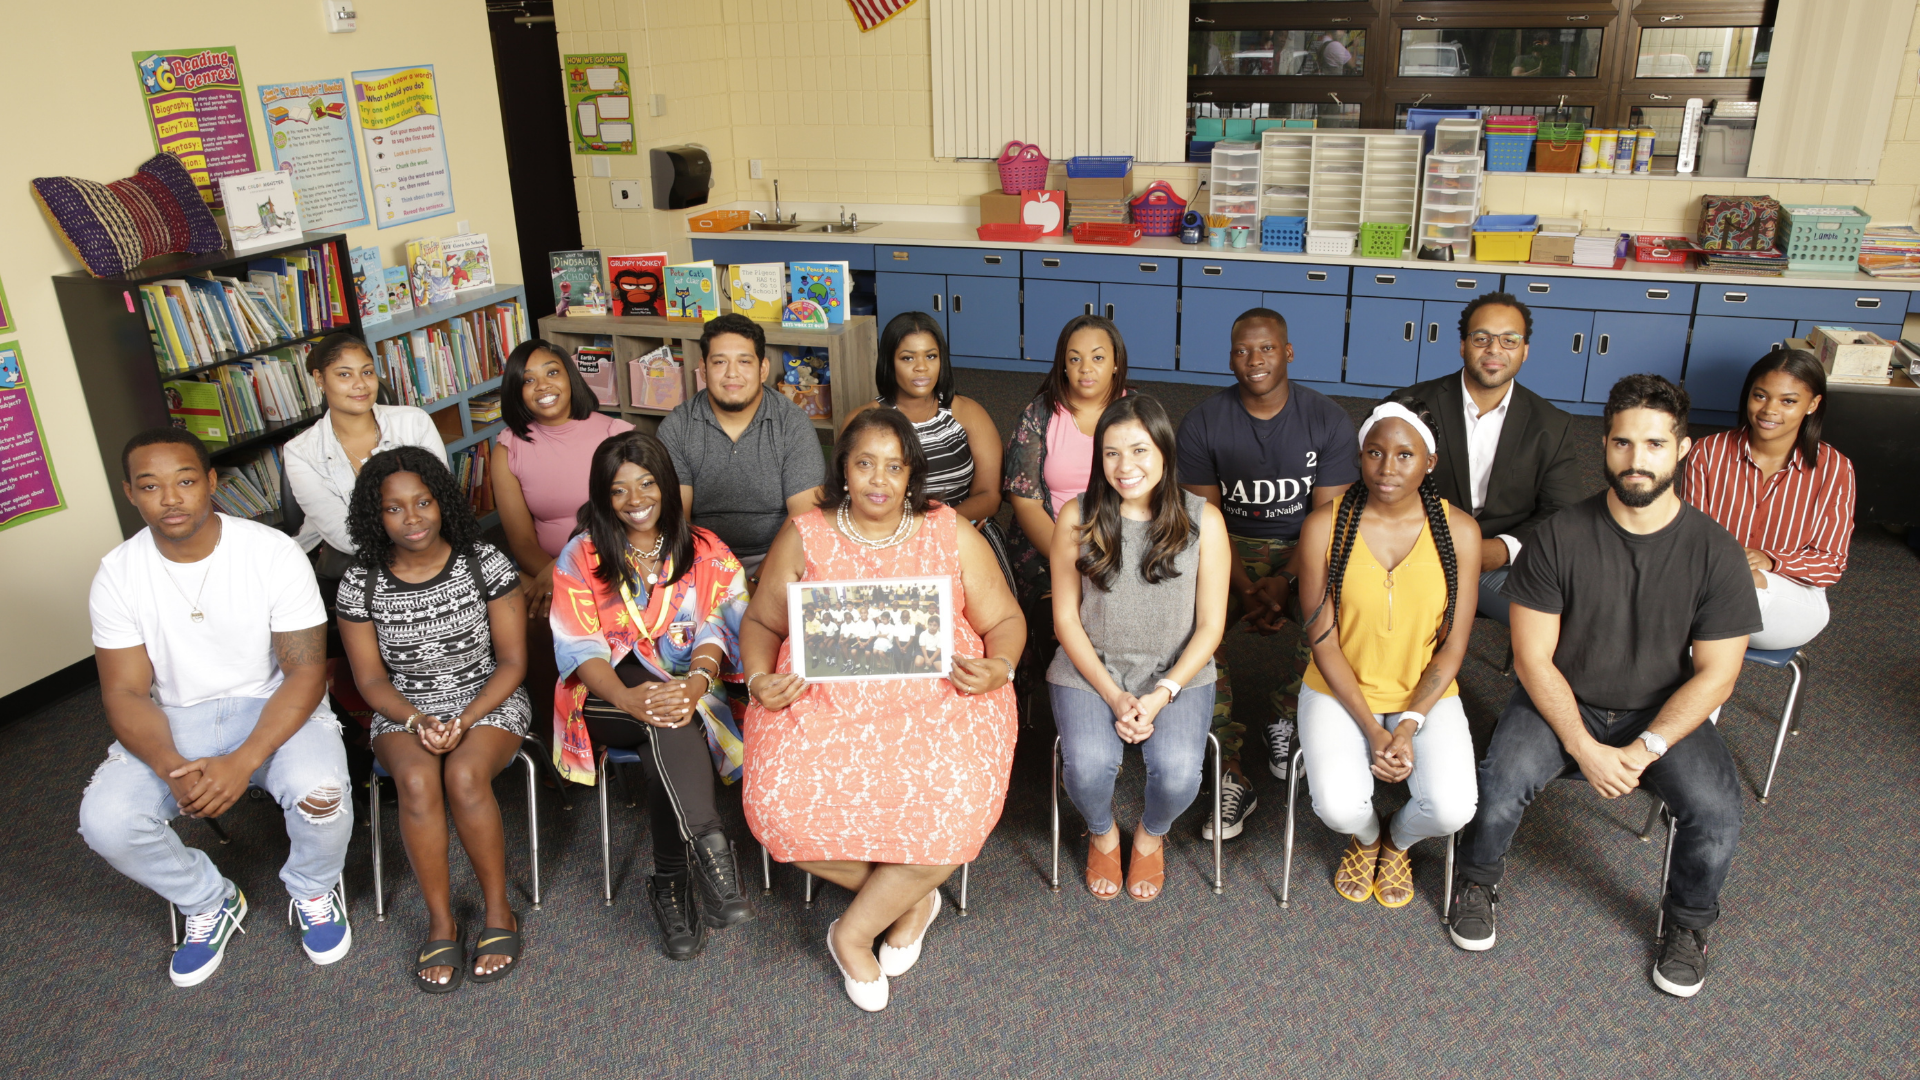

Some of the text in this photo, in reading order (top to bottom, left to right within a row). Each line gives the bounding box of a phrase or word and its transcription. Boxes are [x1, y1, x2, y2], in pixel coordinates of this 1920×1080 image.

[156, 50, 229, 90] 6 Reading
[184, 64, 236, 90] Genres!
[377, 81, 392, 90] don't
[392, 76, 408, 85] know
[414, 71, 432, 80] word?
[384, 87, 401, 100] should
[402, 85, 412, 95] you
[155, 100, 192, 114] Biography:
[360, 104, 370, 115] Try
[384, 103, 390, 111] of
[391, 99, 405, 108] these
[406, 92, 433, 102] strategies
[370, 117, 383, 126] give
[384, 115, 395, 124] you
[401, 106, 413, 116] clue!
[160, 120, 196, 134] Fairy Tale:
[167, 142, 199, 152] Fantasy:
[363, 251, 376, 261] Cat
[16, 437, 33, 446] words?
[12, 451, 37, 461] sentences
[1306, 451, 1316, 467] 2
[13, 494, 30, 503] opinion
[18, 499, 32, 508] read?
[1265, 502, 1303, 518] Ja'Naijah
